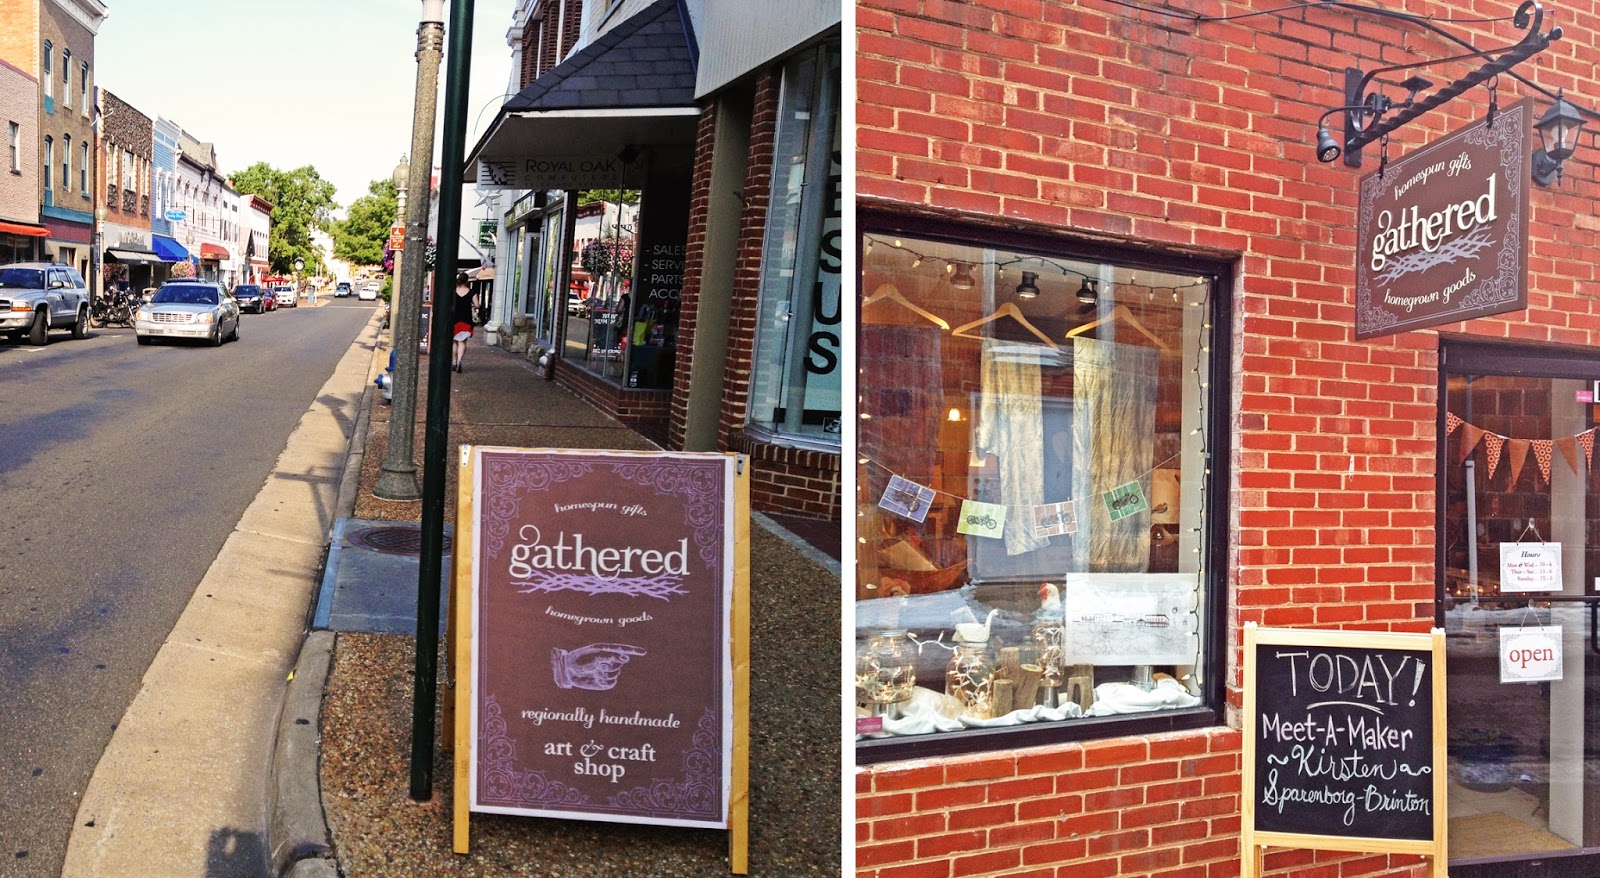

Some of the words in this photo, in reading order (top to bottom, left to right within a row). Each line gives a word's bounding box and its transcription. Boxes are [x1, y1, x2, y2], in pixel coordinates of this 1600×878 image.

[525, 159, 576, 173] ROYAL
[580, 158, 617, 173] OAK
[1394, 160, 1445, 200] homespun
[1447, 151, 1472, 177] gifts
[1371, 172, 1497, 271] gathered
[803, 148, 841, 375] ESUS
[1384, 288, 1439, 312] homegrown
[1442, 267, 1476, 304] goods
[554, 502, 617, 513] homespun
[620, 503, 648, 517] gifts
[508, 524, 691, 581] gathered
[545, 605, 614, 626] homegrown
[618, 611, 653, 627] goods
[1509, 647, 1554, 669] open
[1275, 651, 1426, 707] TODAY!
[521, 707, 596, 729] regionally
[599, 709, 681, 729] handmade
[1262, 713, 1414, 751] Meet-A-Maker
[544, 742, 573, 756] art
[580, 739, 604, 758] &
[608, 743, 657, 762] craft
[1291, 745, 1397, 781] Kirsten
[574, 758, 626, 784] shop
